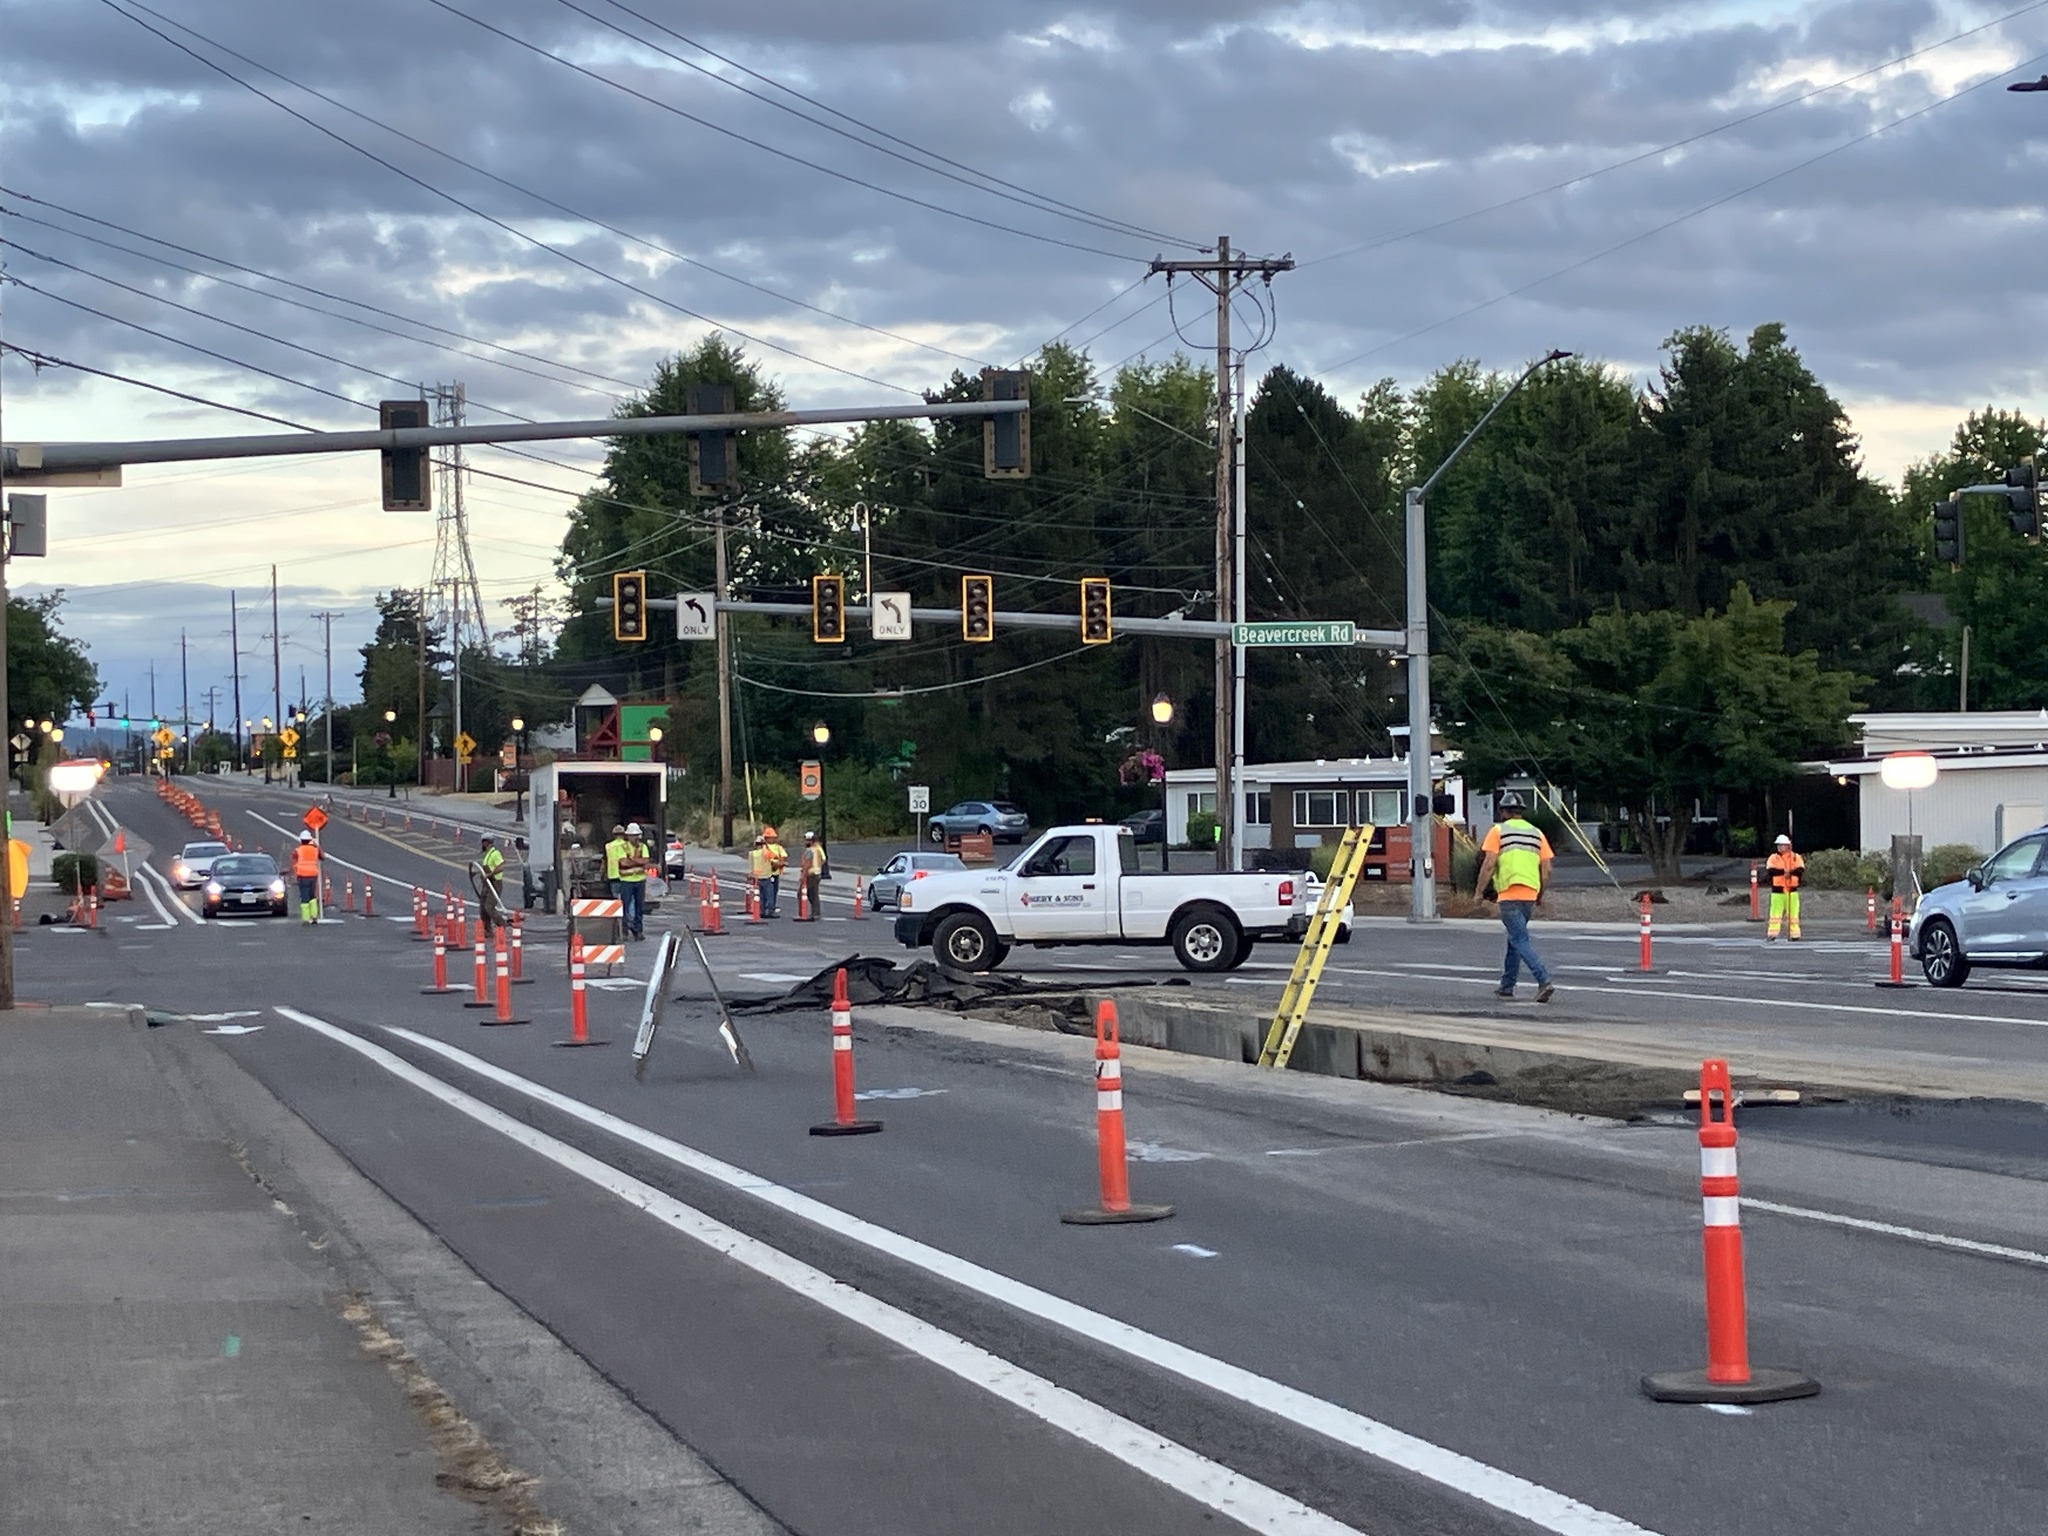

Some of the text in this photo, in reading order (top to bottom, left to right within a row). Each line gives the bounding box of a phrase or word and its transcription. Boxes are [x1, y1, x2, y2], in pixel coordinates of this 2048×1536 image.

[683, 625, 709, 635] ONLY
[880, 625, 905, 635] ONLY
[1239, 625, 1349, 643] Beavercreek Rd
[912, 800, 927, 809] 30
